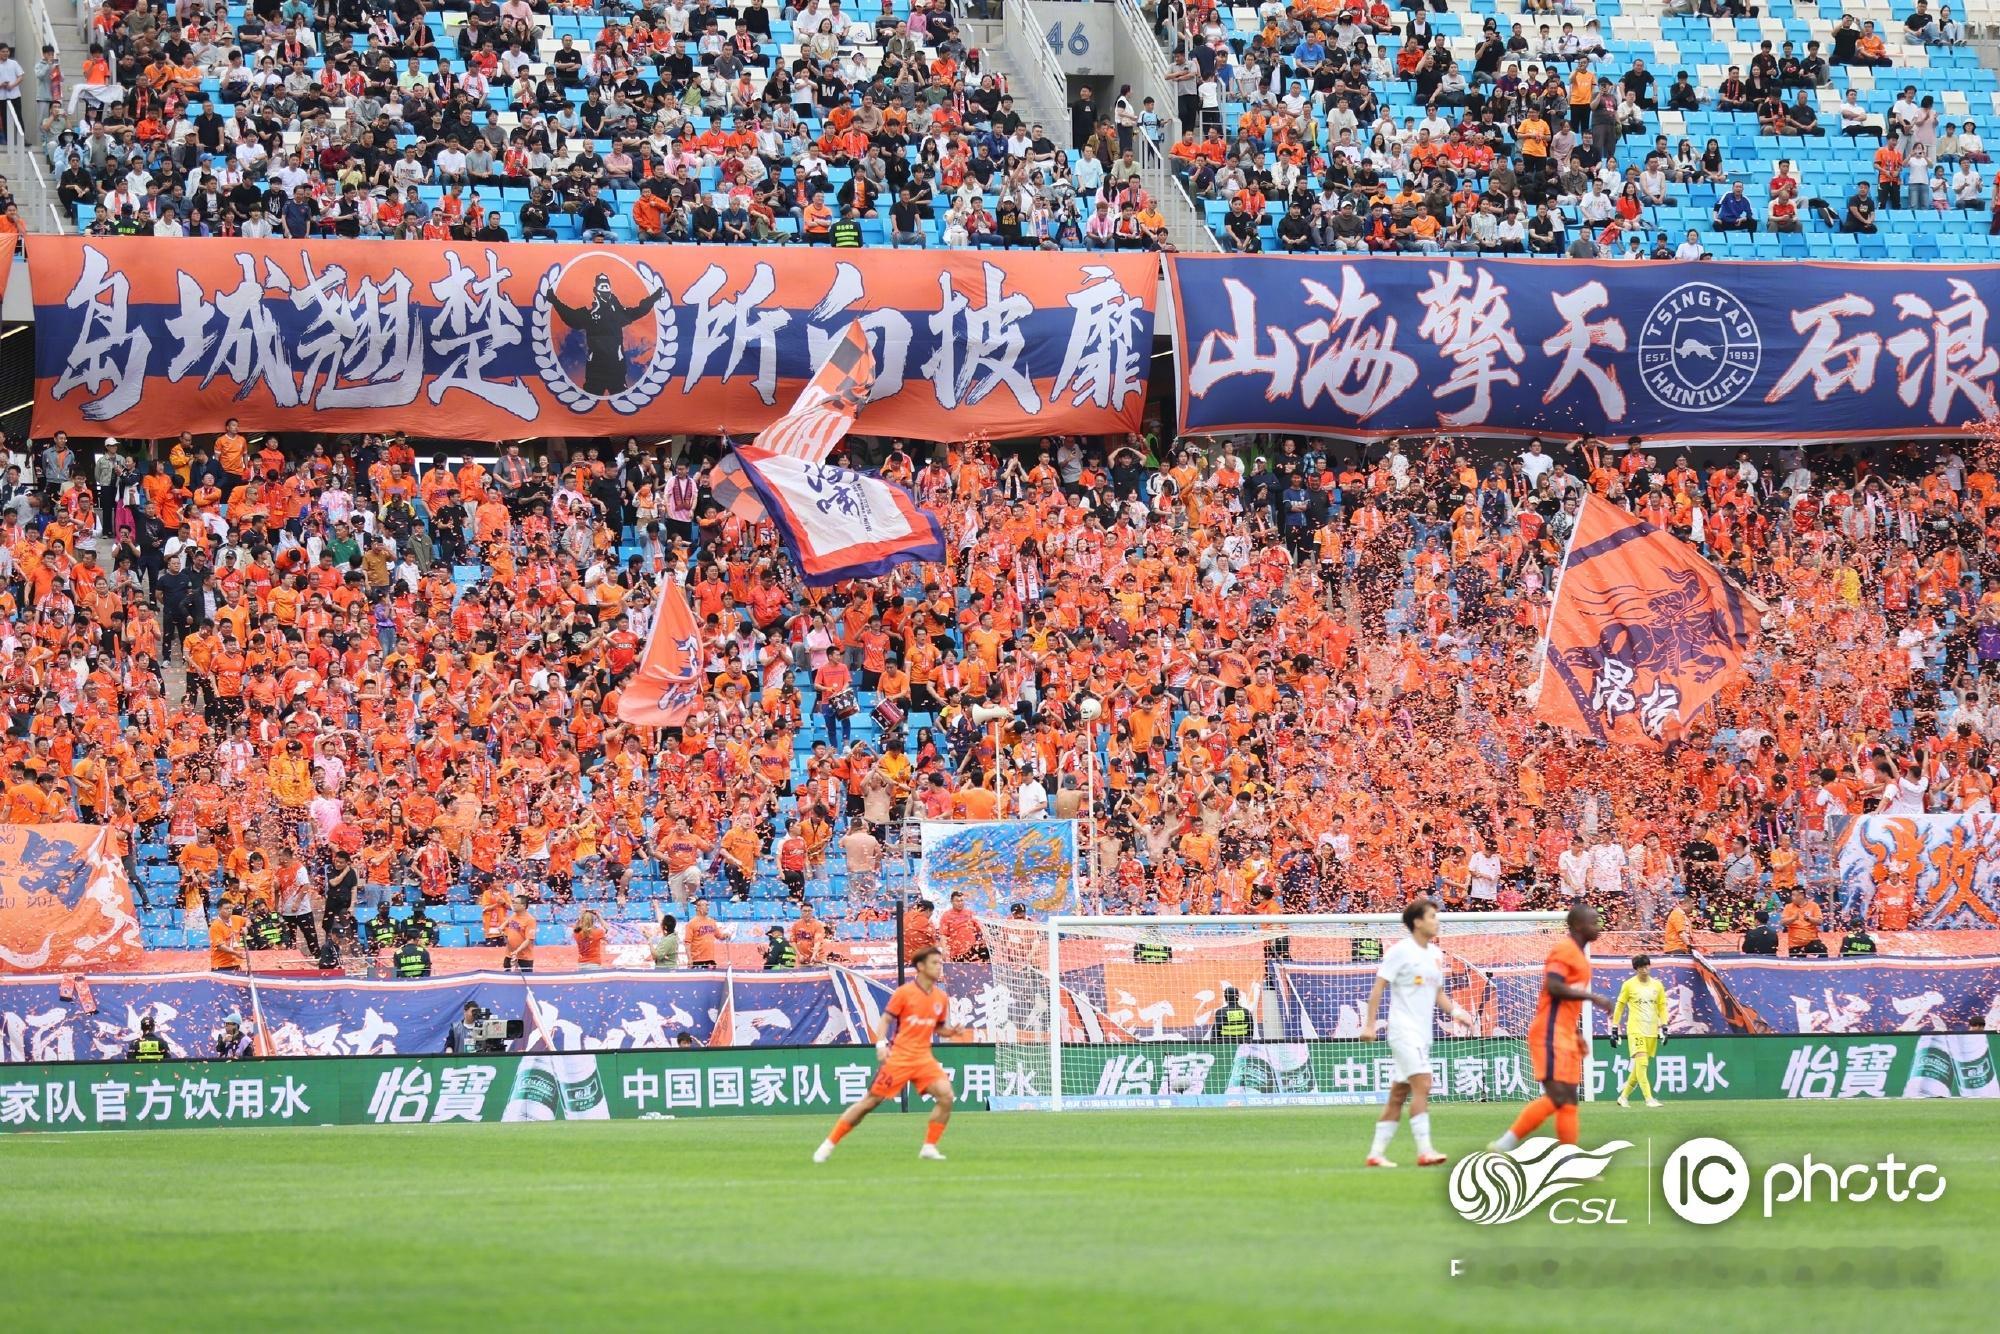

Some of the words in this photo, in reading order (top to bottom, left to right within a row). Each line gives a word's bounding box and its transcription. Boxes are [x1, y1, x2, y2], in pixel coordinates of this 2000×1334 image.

[1046, 20, 1090, 56] 46
[681, 260, 1144, 415] 所向披靡
[1647, 291, 1753, 338] TSINGTAO
[1188, 260, 1629, 427] 山海擎天
[1764, 278, 2000, 424] 石浪
[1645, 353, 1669, 363] EST.
[1729, 351, 1755, 360] 1993
[367, 1065, 497, 1123] 怡寶
[623, 1062, 1039, 1108] 中国国家队官用水
[1334, 1052, 1730, 1096] 中国家队饮用水
[1781, 1043, 1897, 1098] 怡寶
[0, 1076, 311, 1124] 家队官方饮用水
